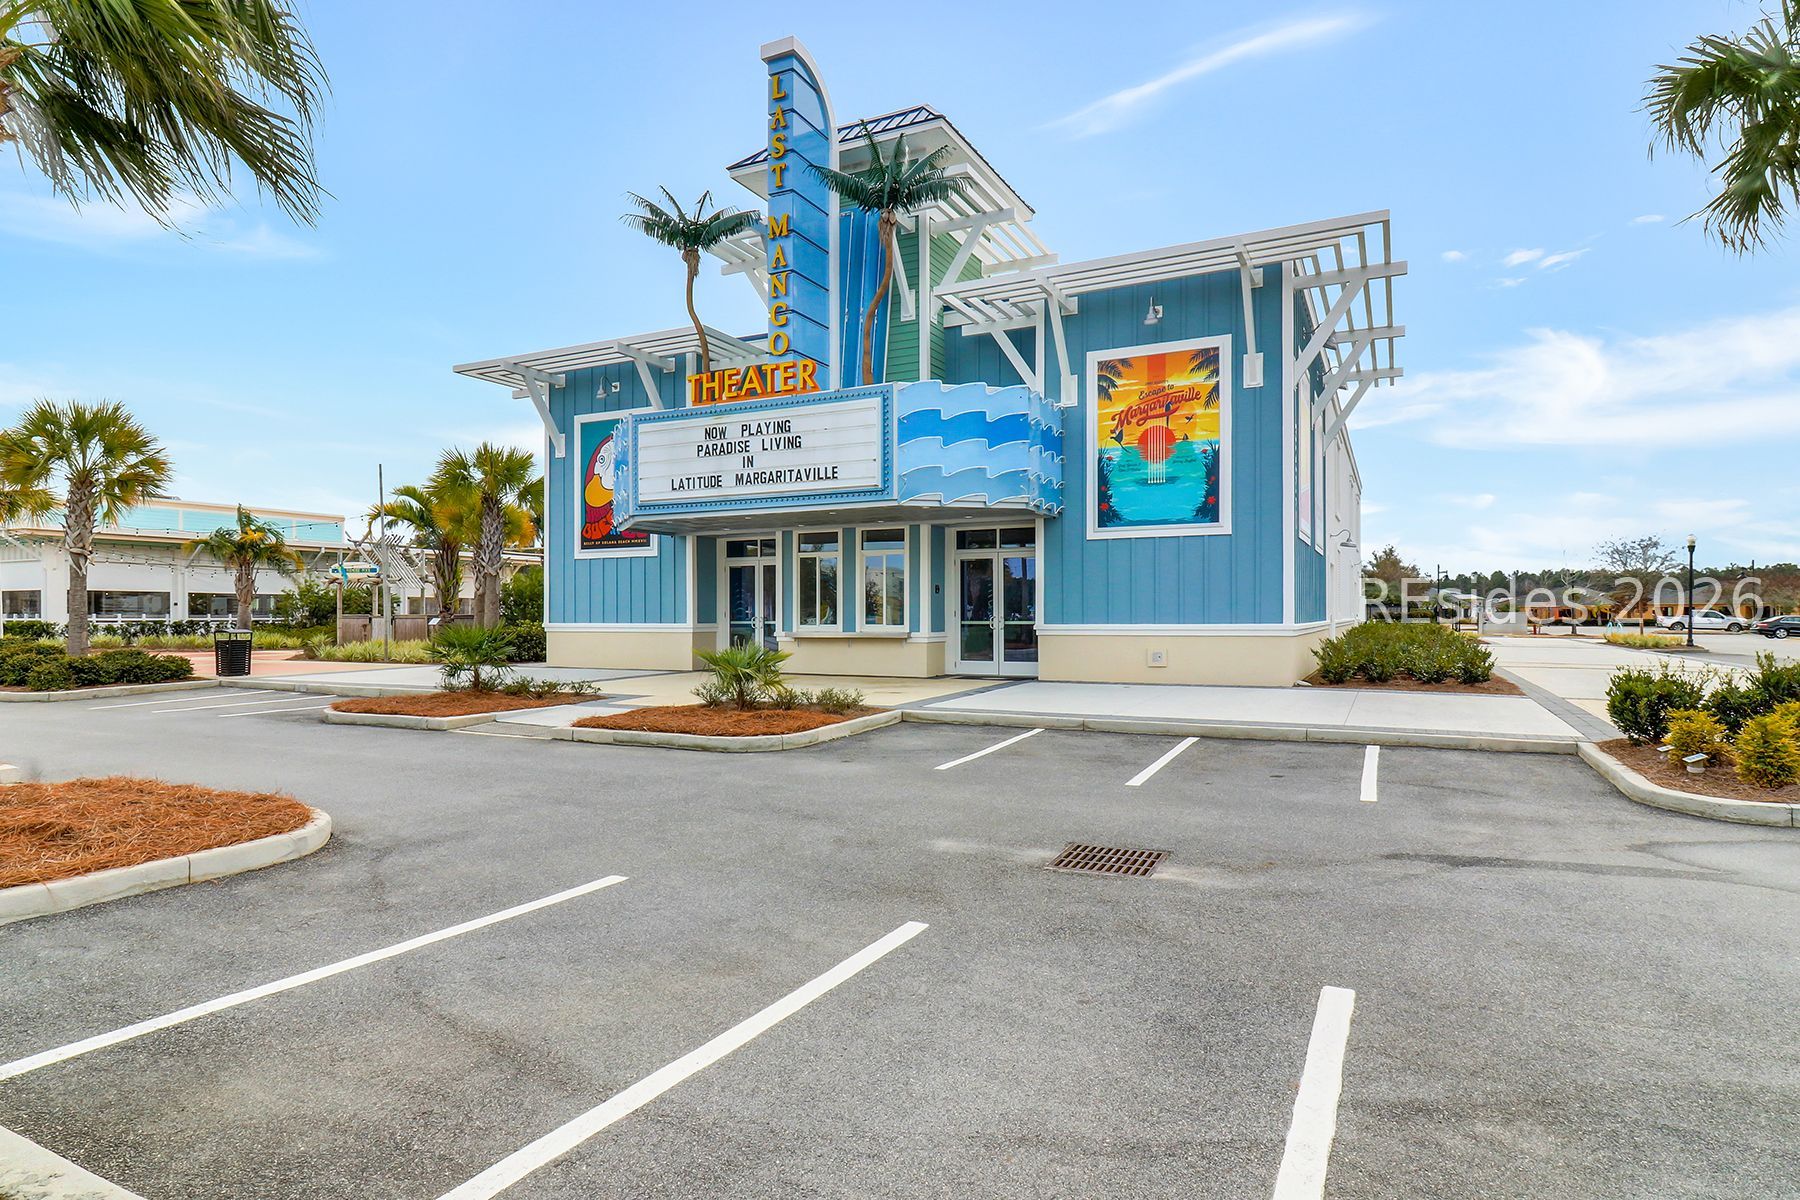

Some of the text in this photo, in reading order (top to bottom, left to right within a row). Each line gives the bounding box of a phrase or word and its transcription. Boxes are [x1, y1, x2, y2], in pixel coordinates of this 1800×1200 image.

[768, 74, 789, 356] LAST MANGO
[687, 359, 820, 404] THEATER
[1138, 385, 1166, 400] Escape
[1110, 387, 1202, 434] Margaritaville
[704, 419, 791, 440] NOW PLAYING
[697, 435, 802, 457] PARADISE LIVING
[742, 455, 754, 468] IN
[671, 466, 838, 491] LATITUDE MARGARITAVILLE
